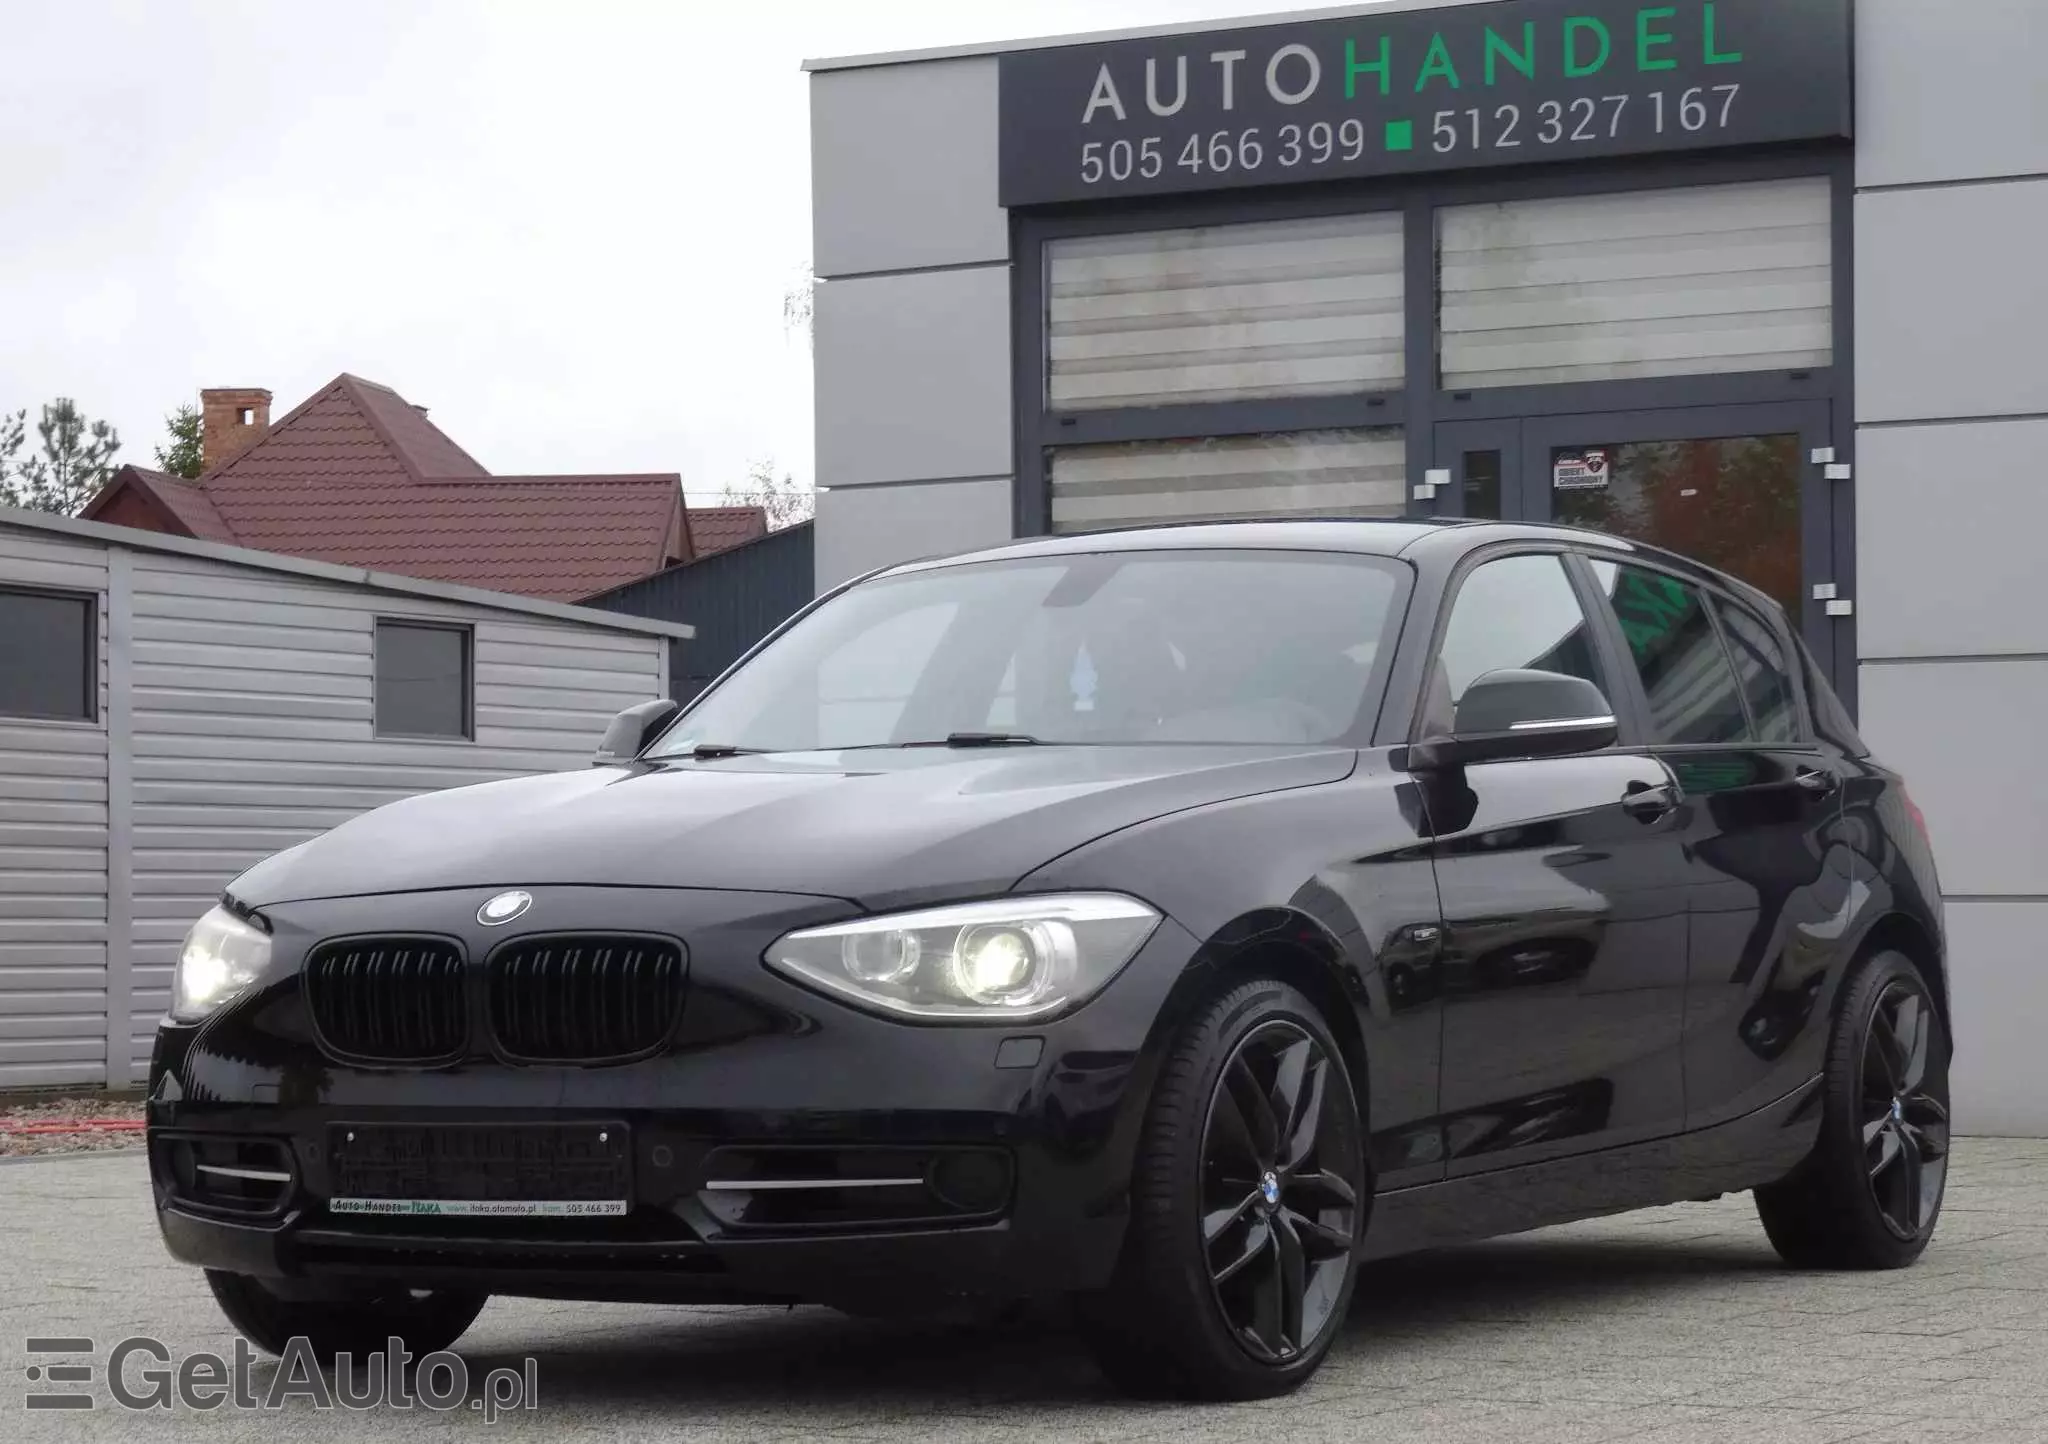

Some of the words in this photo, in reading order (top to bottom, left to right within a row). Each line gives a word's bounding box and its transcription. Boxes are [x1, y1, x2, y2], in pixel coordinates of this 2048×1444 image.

[1080, 138, 1163, 184] 505
[1177, 127, 1263, 176] 466
[1276, 118, 1365, 167] 399
[1432, 104, 1522, 154] 512
[1536, 94, 1631, 145] 327
[1646, 83, 1742, 135] 167
[566, 1202, 583, 1213] 505
[585, 1202, 602, 1213] 466
[605, 1202, 621, 1213] 399
